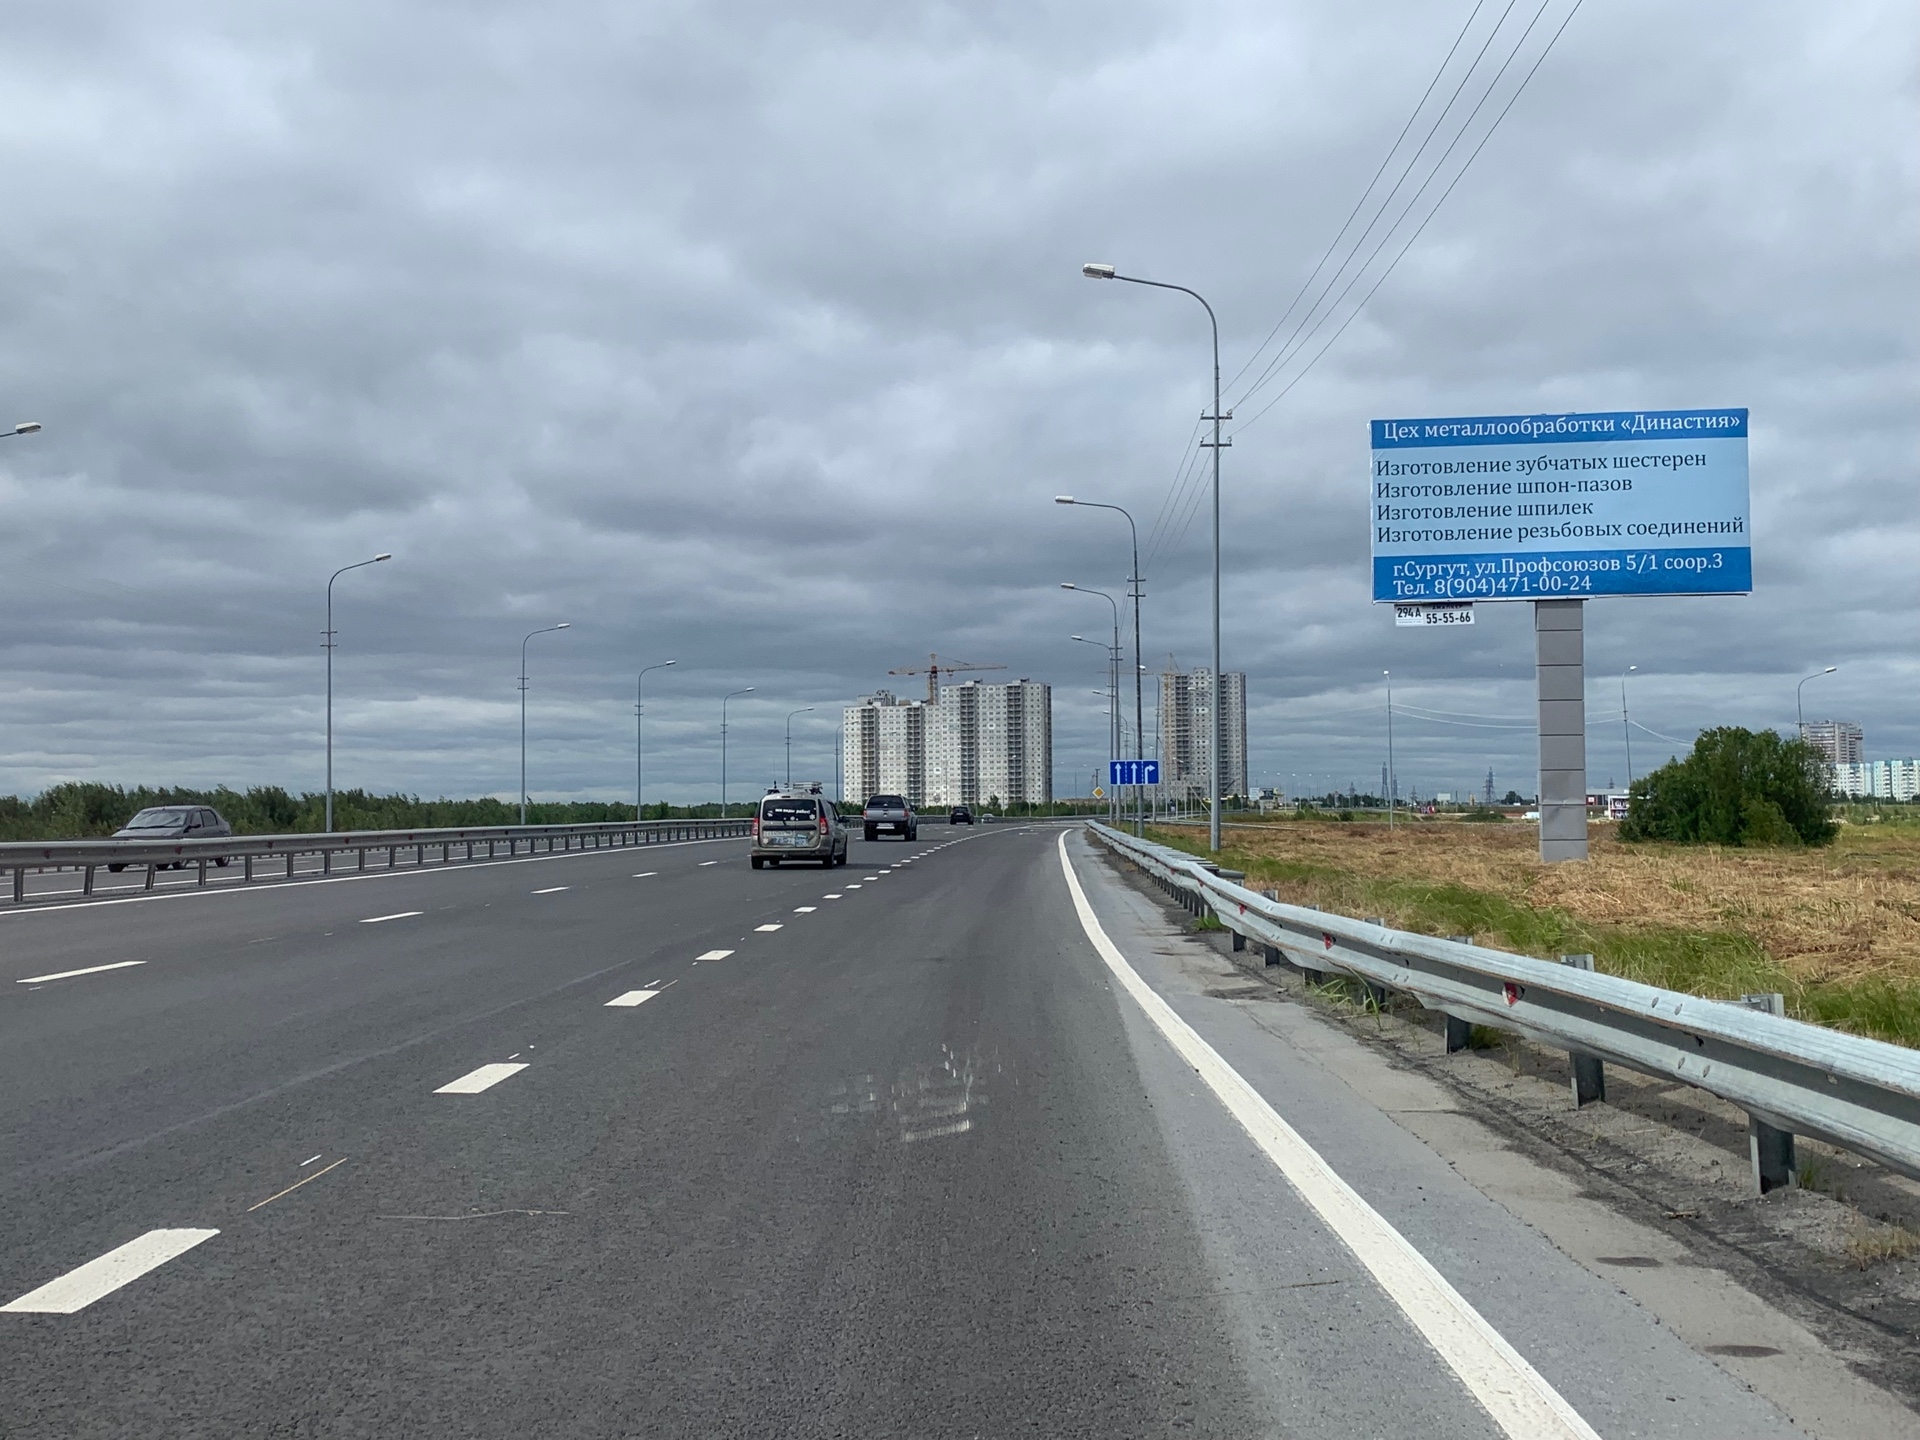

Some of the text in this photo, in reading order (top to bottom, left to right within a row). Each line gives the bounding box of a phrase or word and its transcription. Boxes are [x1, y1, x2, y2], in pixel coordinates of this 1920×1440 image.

[1384, 414, 1741, 442] Цех металлообработки «Династия»
[1376, 454, 1707, 476] Изготовление зубчатых шестерен
[1377, 478, 1633, 498] Изготовление шпон-пазов
[1377, 502, 1594, 521] Изготовление шпилек
[1378, 517, 1744, 543] Изготовление резьбовых соединений
[1393, 552, 1723, 580] г.Сургут, ул.Профсоюзов 5/1 соор.3
[1393, 575, 1593, 598] Тел. 8(904)471-00-24
[1425, 611, 1471, 625] 55-55-66
